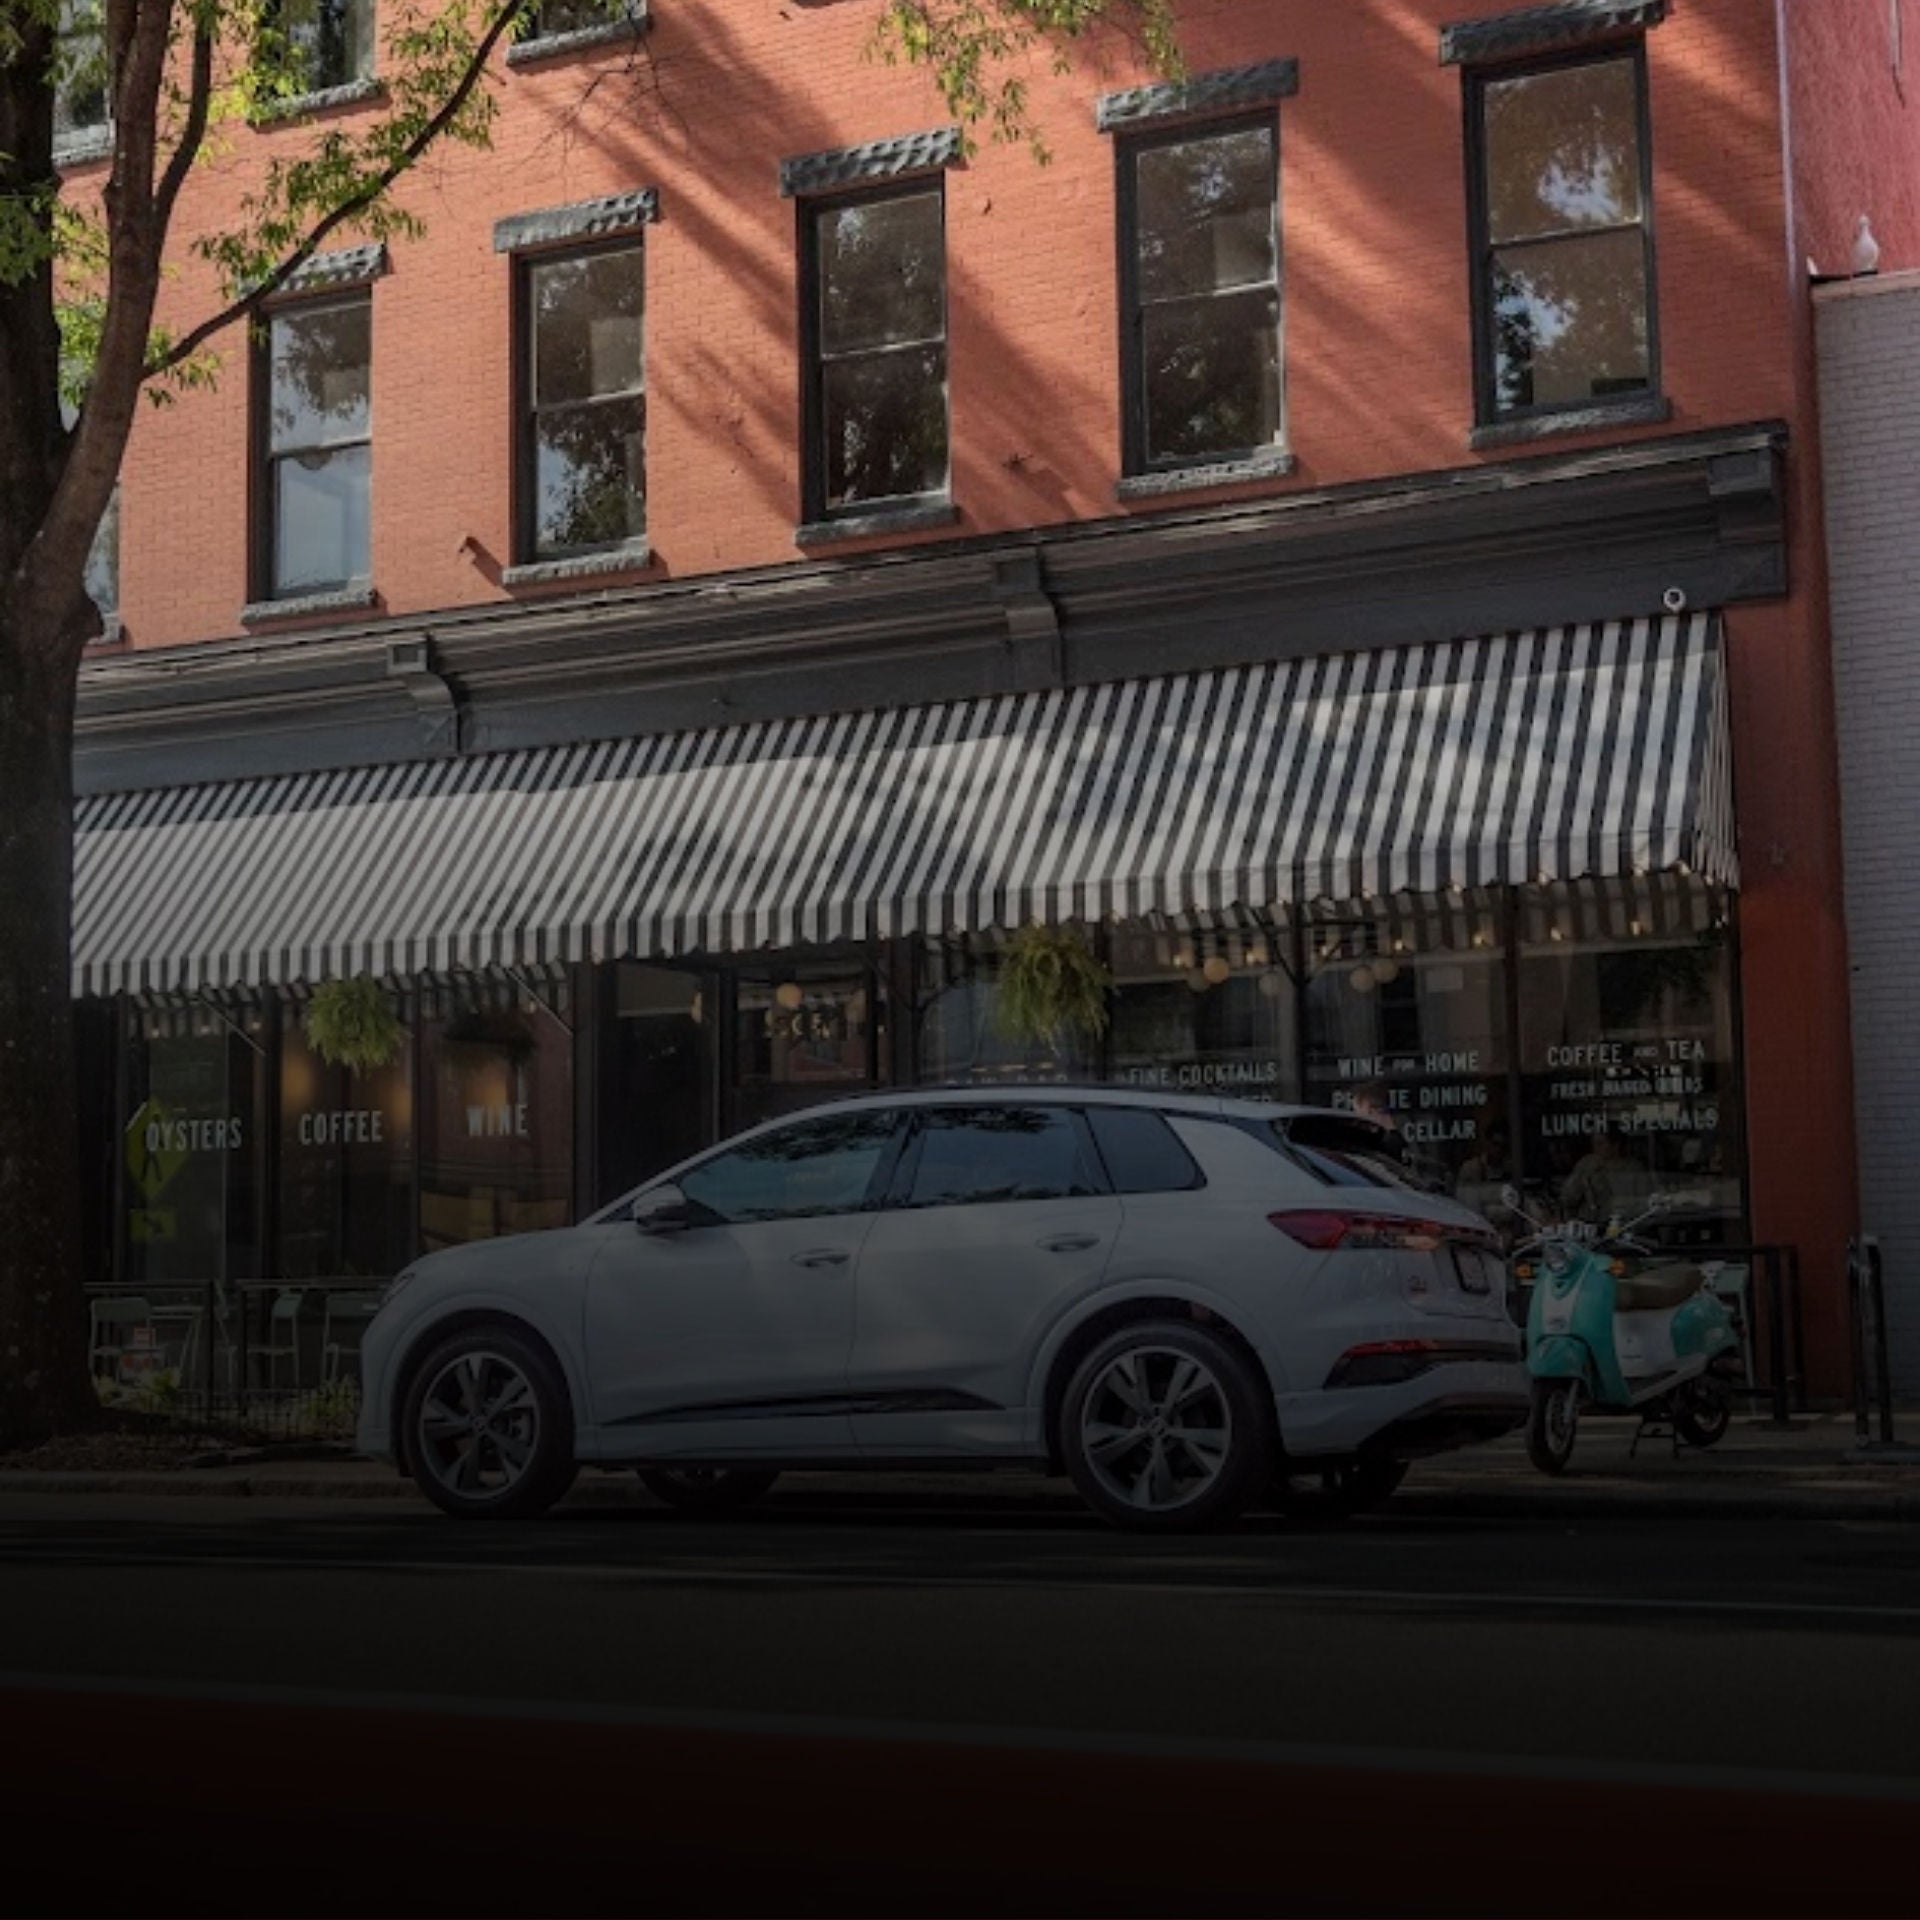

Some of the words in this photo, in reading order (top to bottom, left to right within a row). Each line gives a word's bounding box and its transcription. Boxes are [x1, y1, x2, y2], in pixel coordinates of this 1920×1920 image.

[1337, 1056, 1384, 1078] WINE
[1425, 1051, 1480, 1072] HOME
[1547, 1043, 1622, 1066] COFFEE
[1667, 1040, 1705, 1061] TEA
[1129, 1067, 1169, 1085] FINE
[1179, 1062, 1278, 1085] COCKTAILS
[1331, 1088, 1411, 1110] PRTE
[1419, 1083, 1488, 1108] DINING
[300, 1111, 384, 1146] COFFEE
[466, 1104, 529, 1137] WINE
[1403, 1119, 1477, 1143] CELLAR
[1541, 1113, 1608, 1136] LUNCH
[1619, 1106, 1719, 1133] SPECIALS
[145, 1117, 243, 1152] OYSTERS
